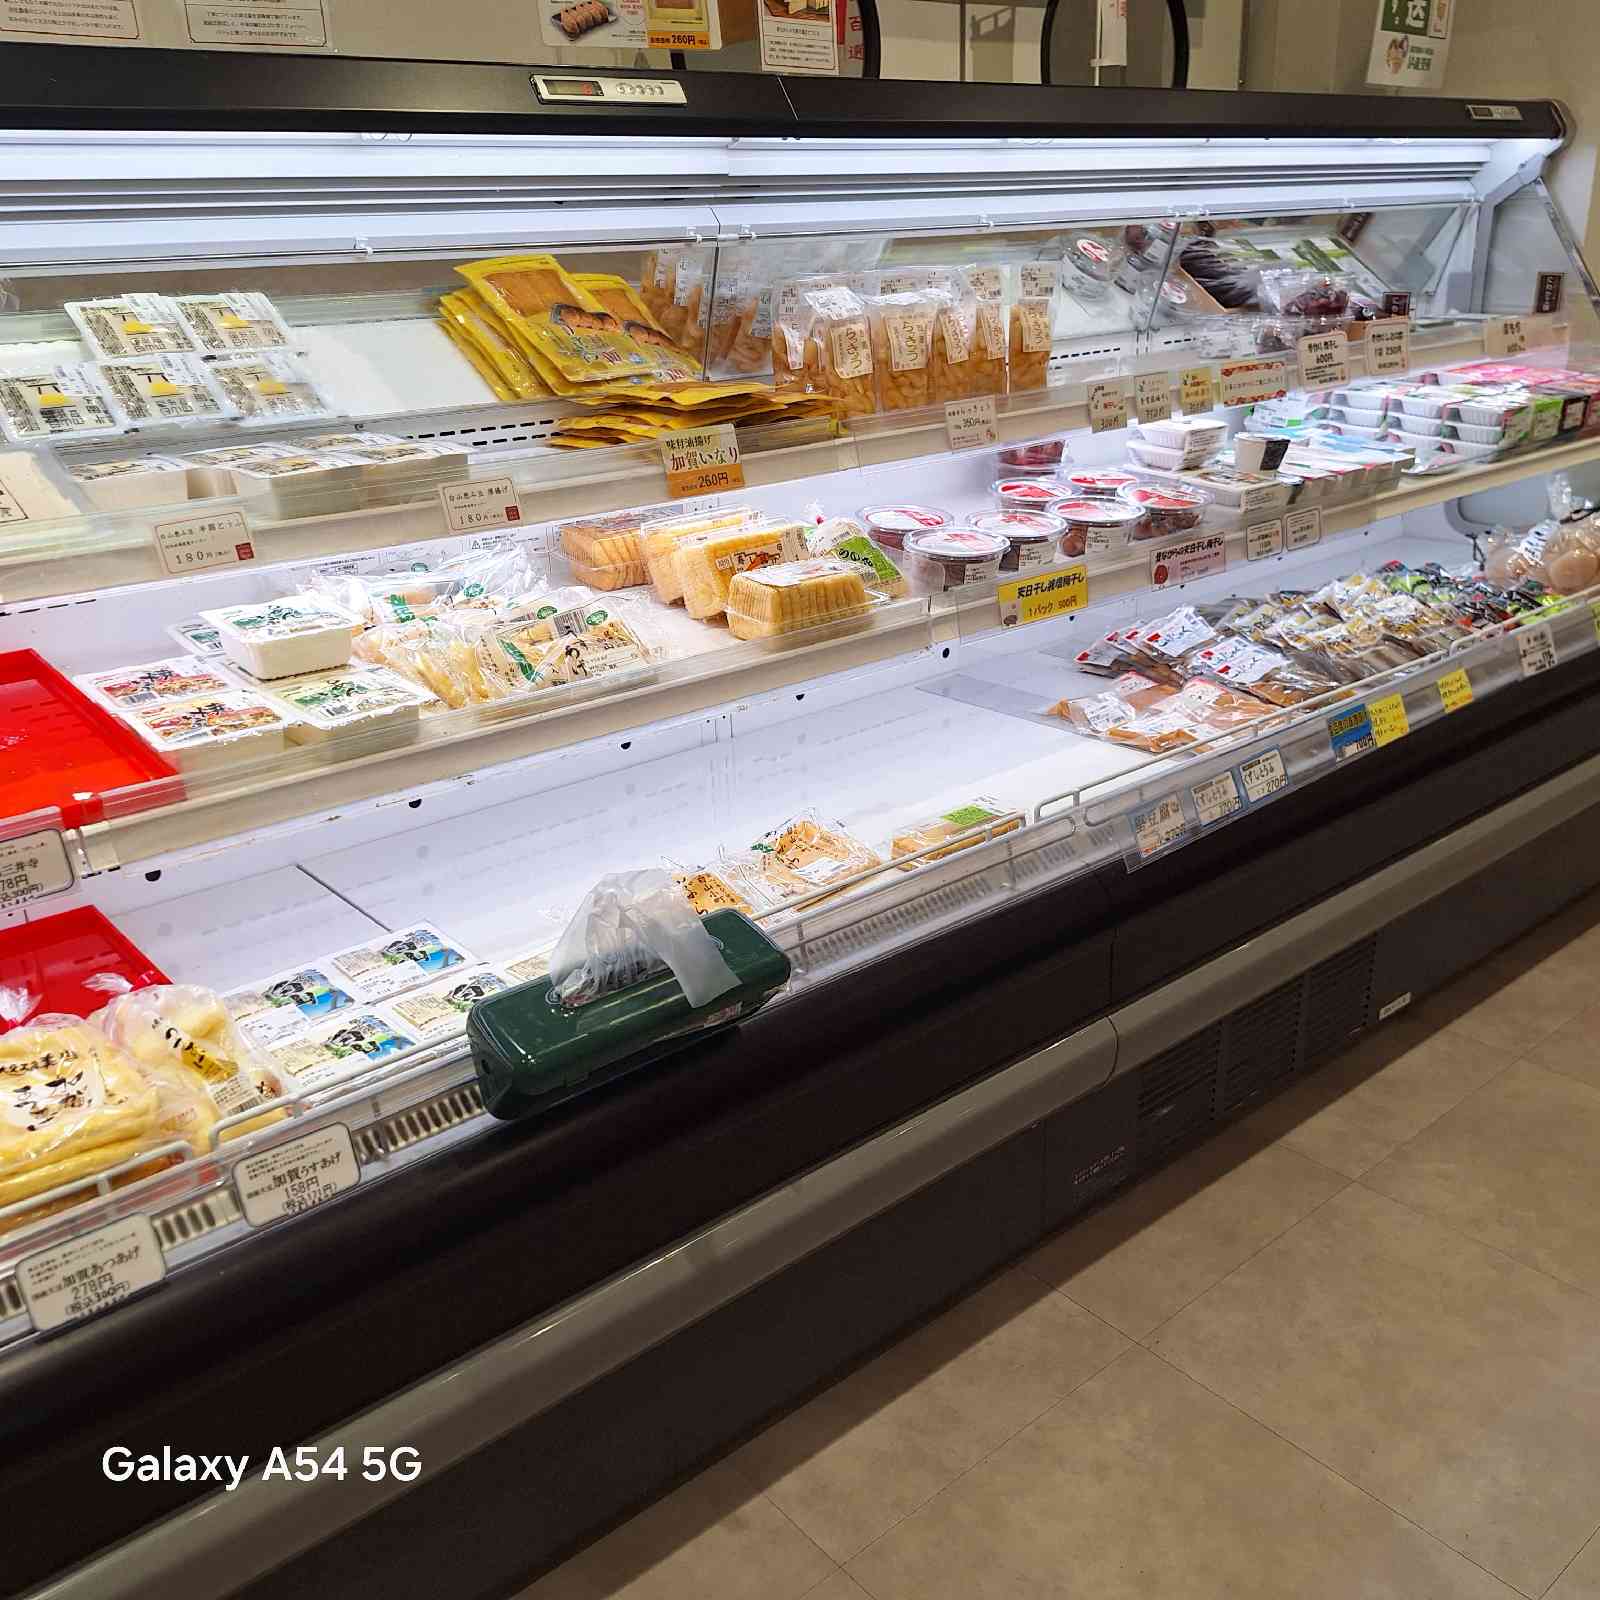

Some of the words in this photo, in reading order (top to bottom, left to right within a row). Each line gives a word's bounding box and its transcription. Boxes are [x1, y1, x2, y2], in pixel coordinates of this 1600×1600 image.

[665, 434, 712, 449] 味付油揚げ
[672, 446, 738, 471] 加賀いなり
[698, 471, 729, 488] 260円
[273, 1151, 341, 1188] 加賀うすあげ
[62, 1245, 140, 1288] 加賀あつあげ
[71, 1272, 115, 1300] 278円
